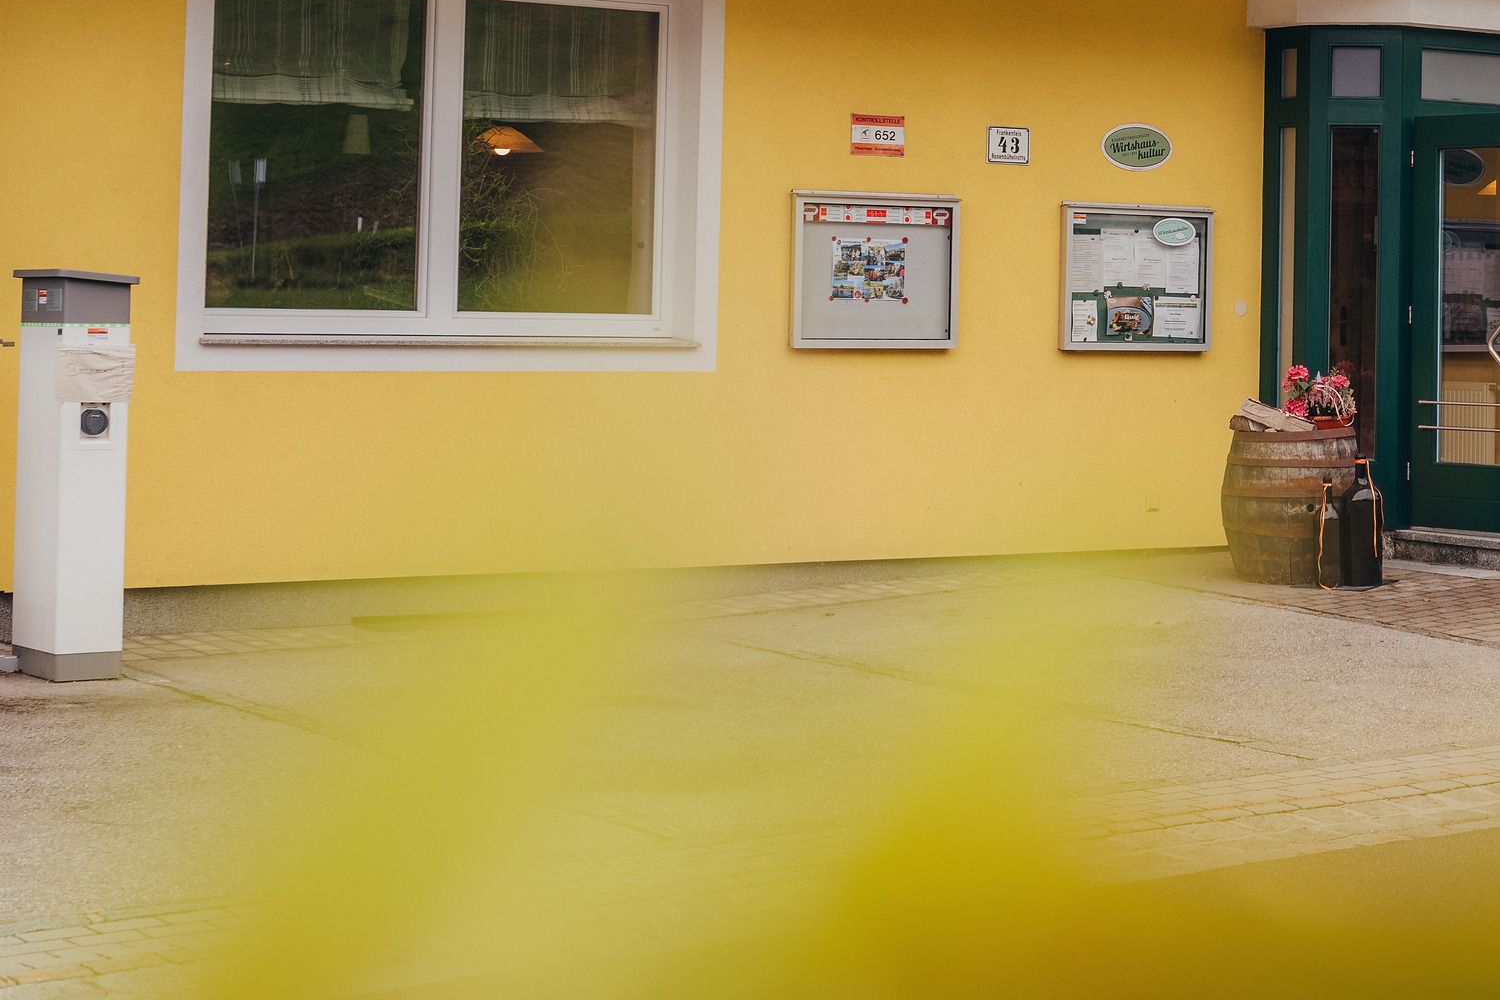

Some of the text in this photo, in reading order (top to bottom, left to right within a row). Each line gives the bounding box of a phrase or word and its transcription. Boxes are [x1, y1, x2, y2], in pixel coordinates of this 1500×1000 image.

[874, 129, 896, 141] 652
[998, 136, 1020, 154] 43
[1137, 148, 1166, 160] kultur
